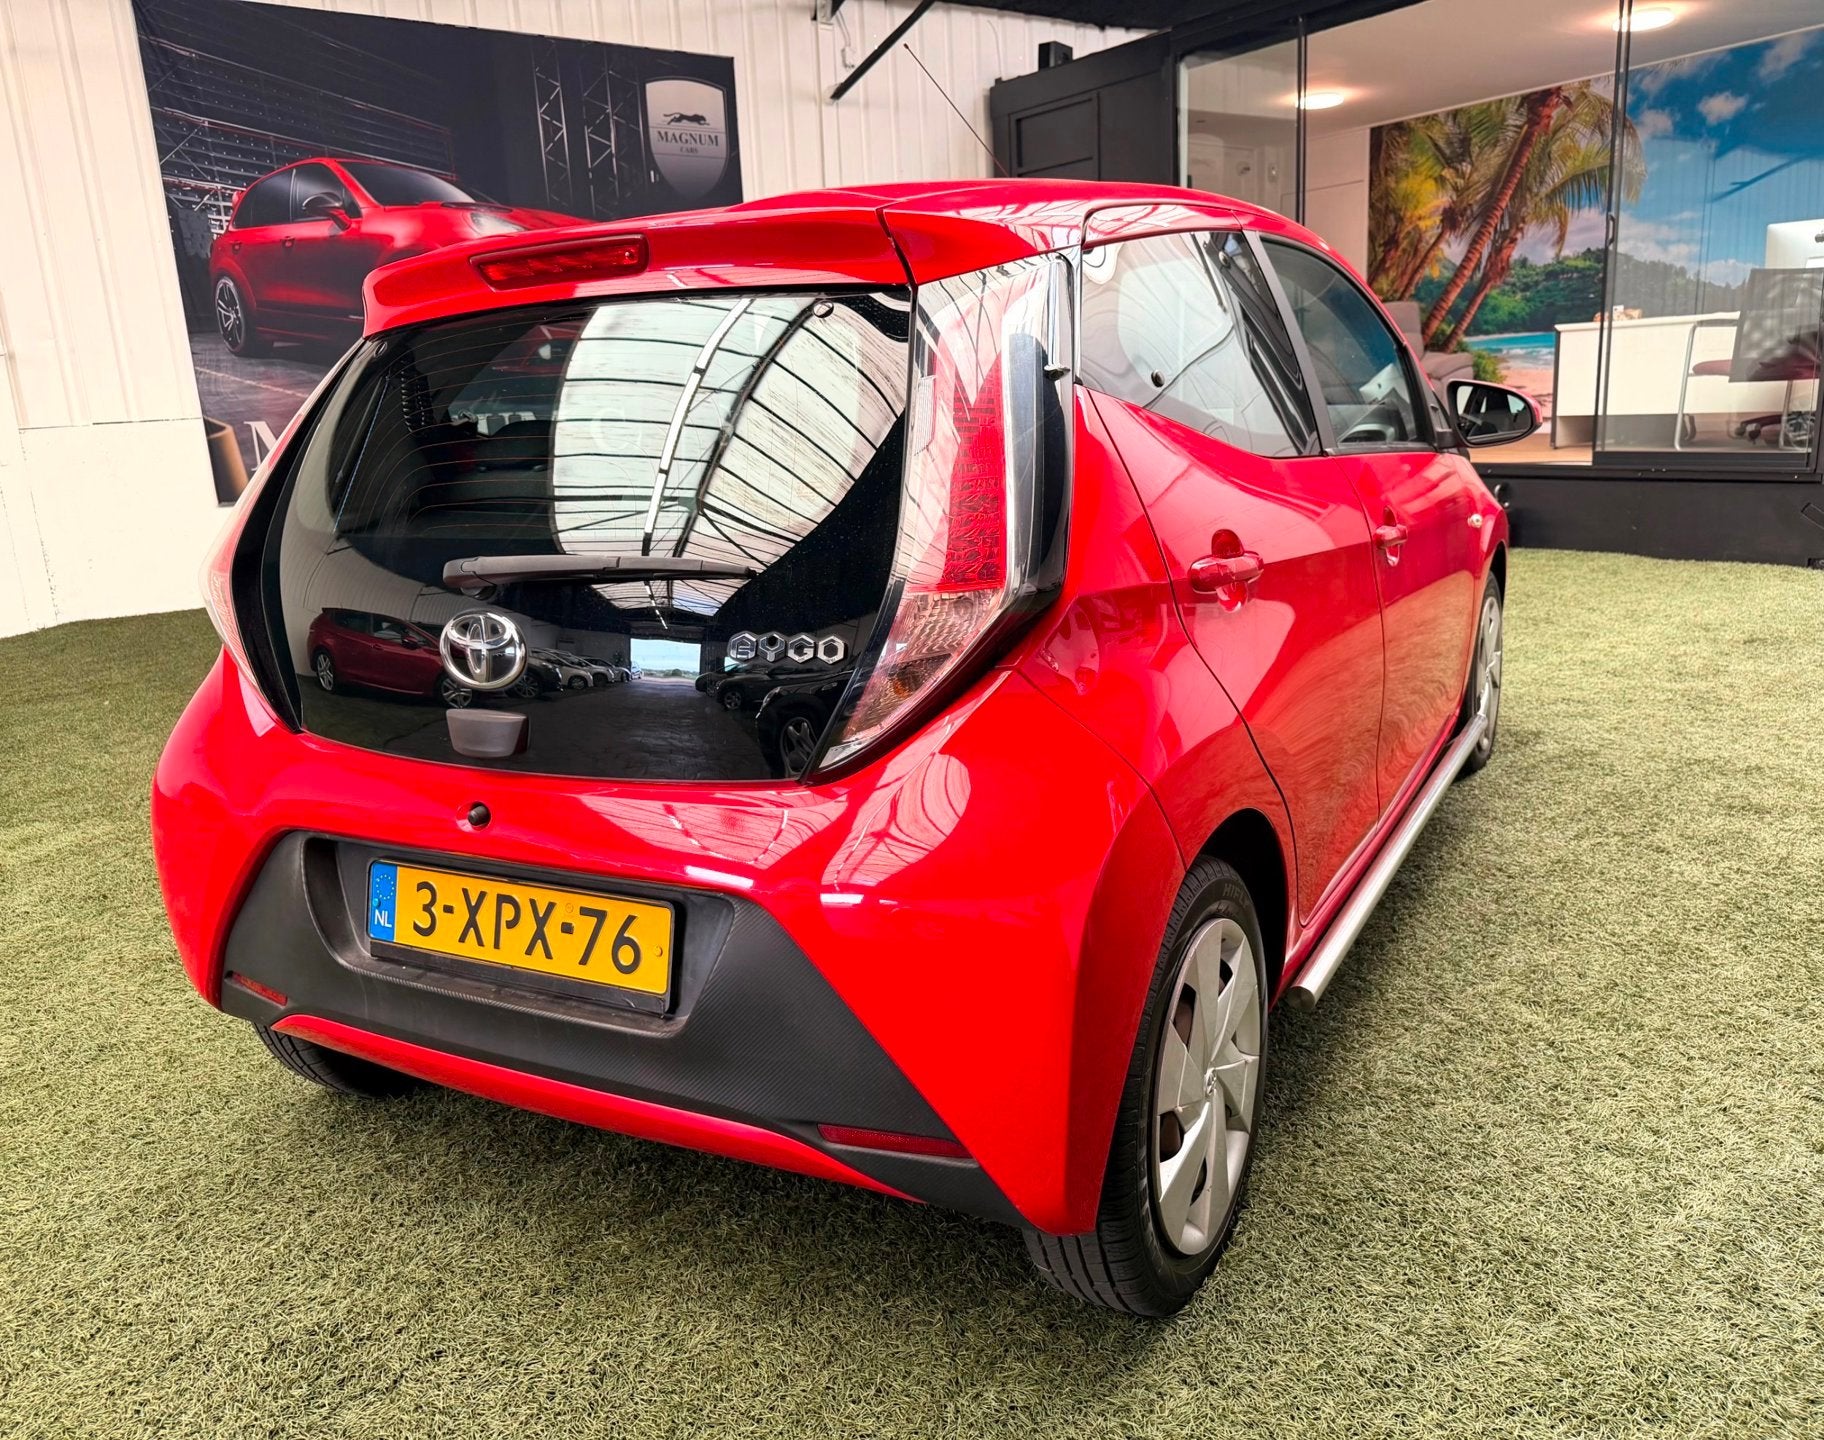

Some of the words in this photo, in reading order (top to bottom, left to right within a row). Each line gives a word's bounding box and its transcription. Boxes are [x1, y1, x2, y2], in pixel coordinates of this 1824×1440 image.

[656, 130, 719, 147] MAGNUM
[679, 146, 699, 155] CARS
[728, 631, 846, 665] AYGO
[374, 909, 393, 928] NL
[412, 881, 642, 975] 3-XPX-76
